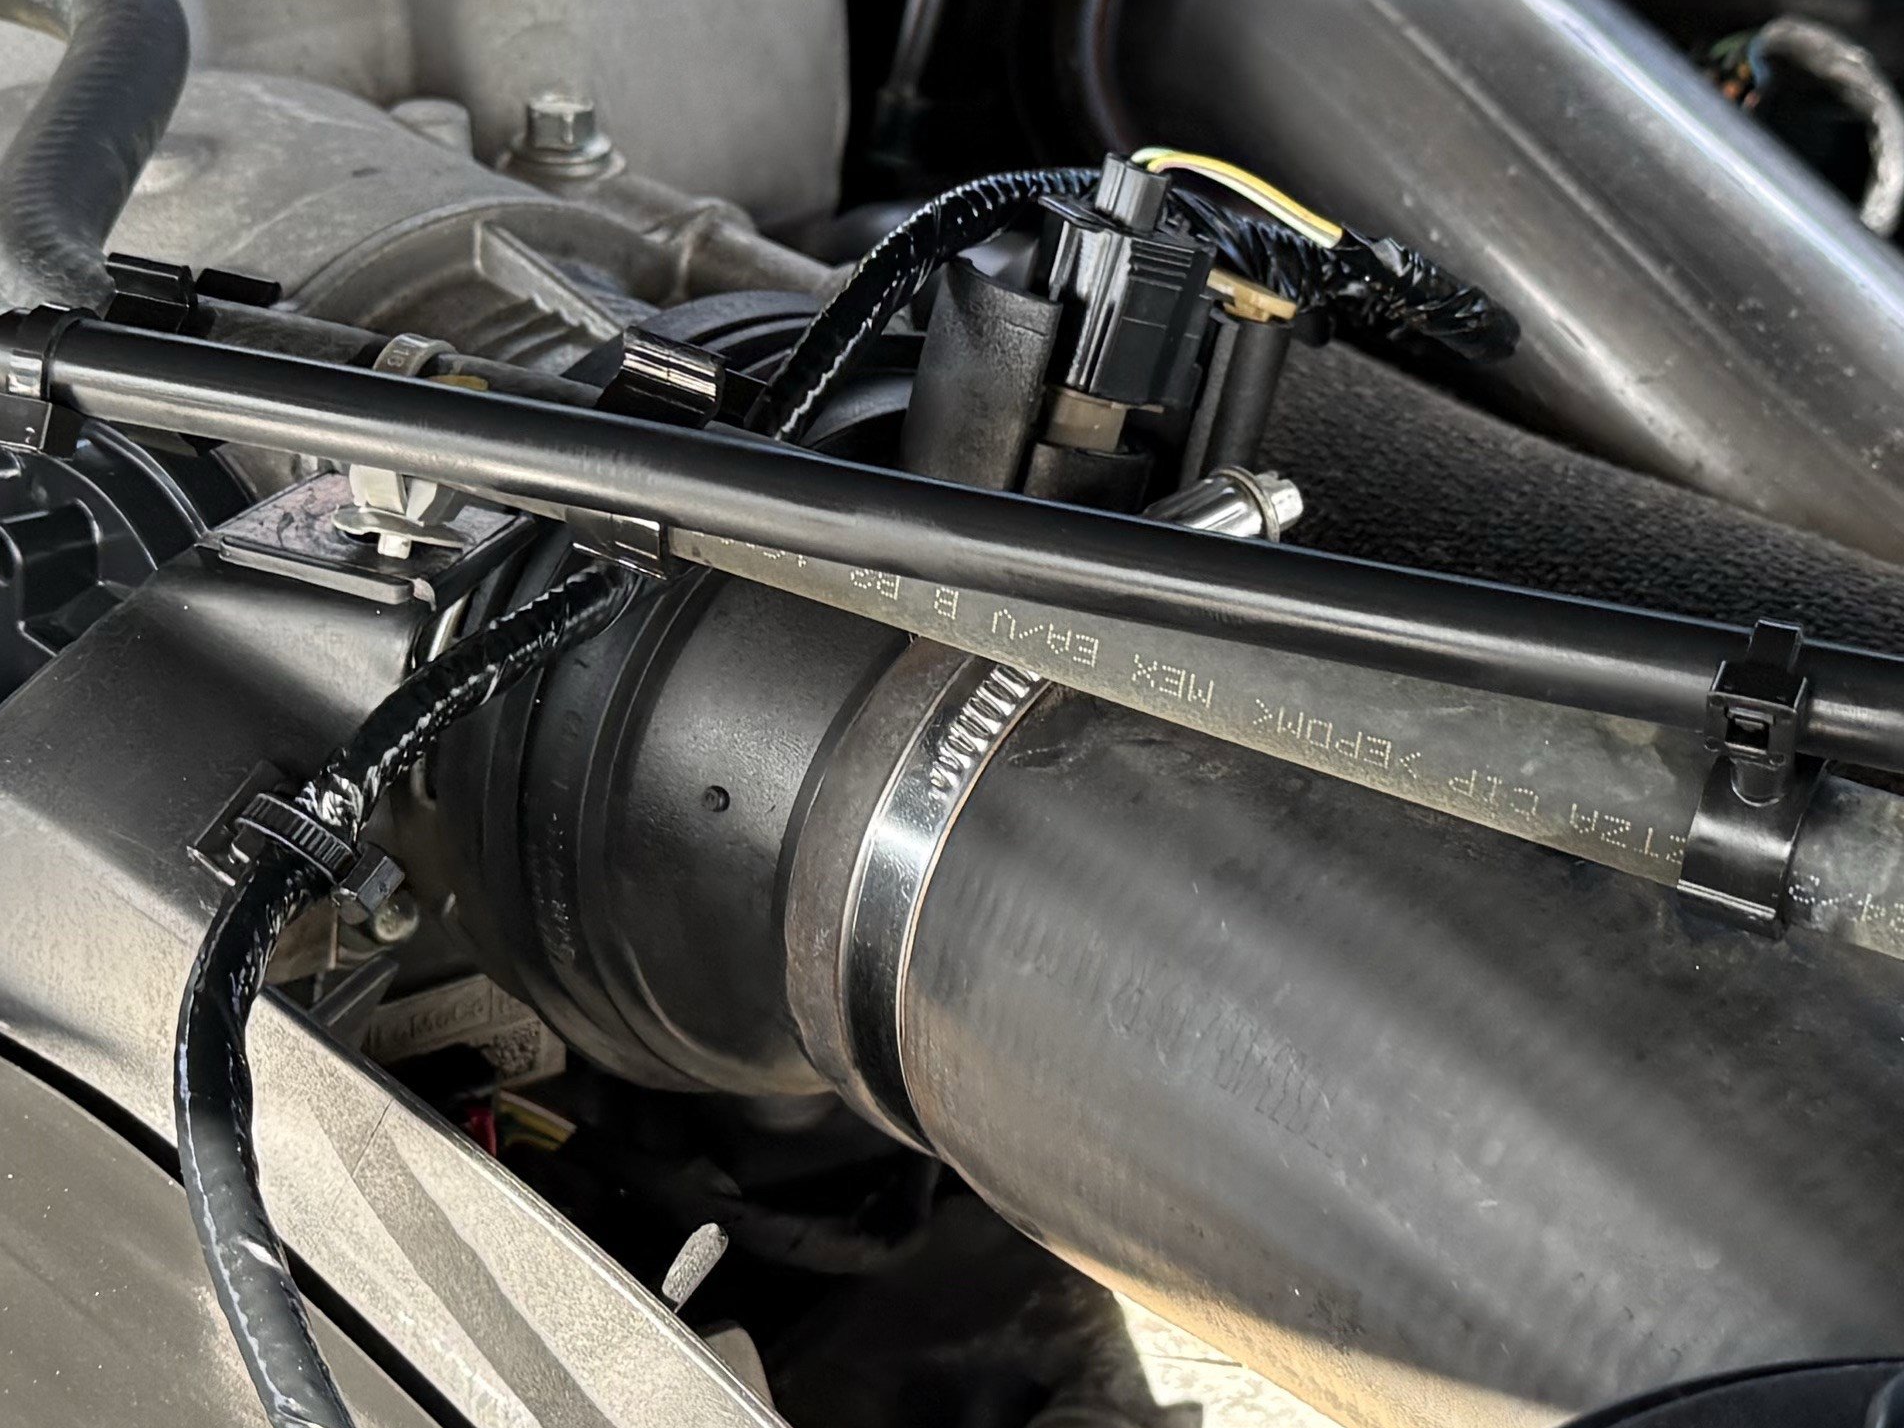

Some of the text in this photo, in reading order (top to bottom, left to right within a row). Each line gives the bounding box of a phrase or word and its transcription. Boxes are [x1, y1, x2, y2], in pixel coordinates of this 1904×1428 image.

[930, 583, 961, 618] B
[1129, 652, 1216, 706] MEX
[1448, 762, 1541, 818] CIP
